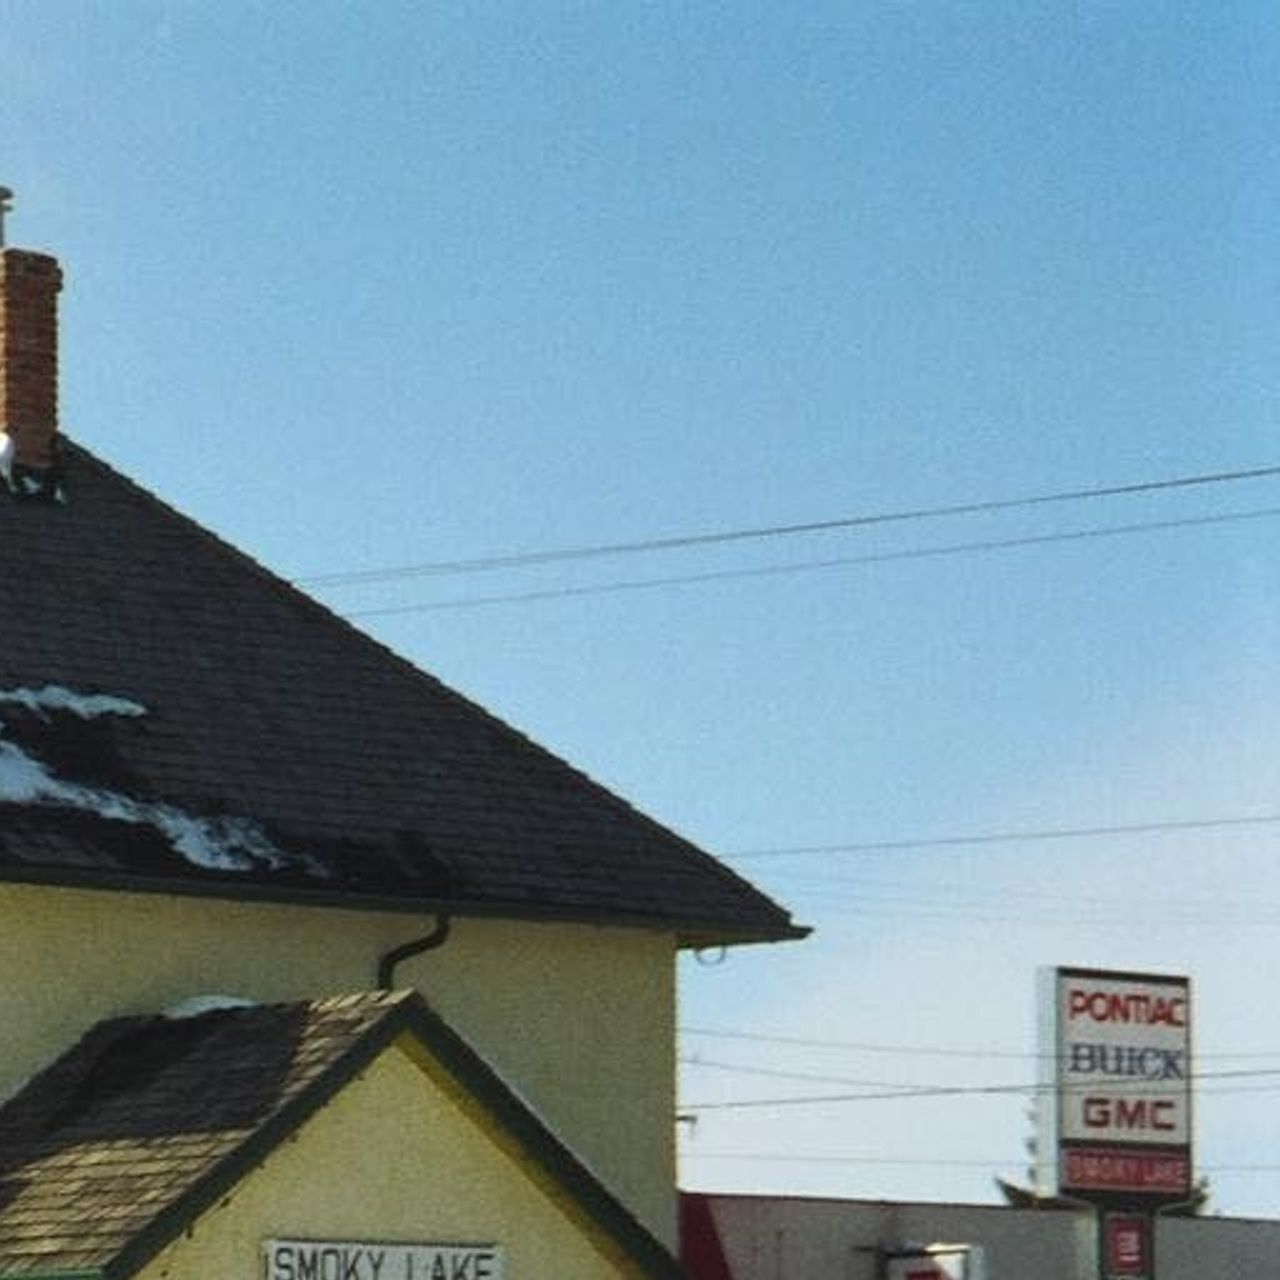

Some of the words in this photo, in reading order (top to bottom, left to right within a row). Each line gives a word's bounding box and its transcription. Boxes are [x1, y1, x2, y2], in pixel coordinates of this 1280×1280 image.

[1069, 990, 1185, 1027] PONTIAC
[1069, 1043, 1184, 1080] BUICK
[1083, 1098, 1176, 1131] GMC
